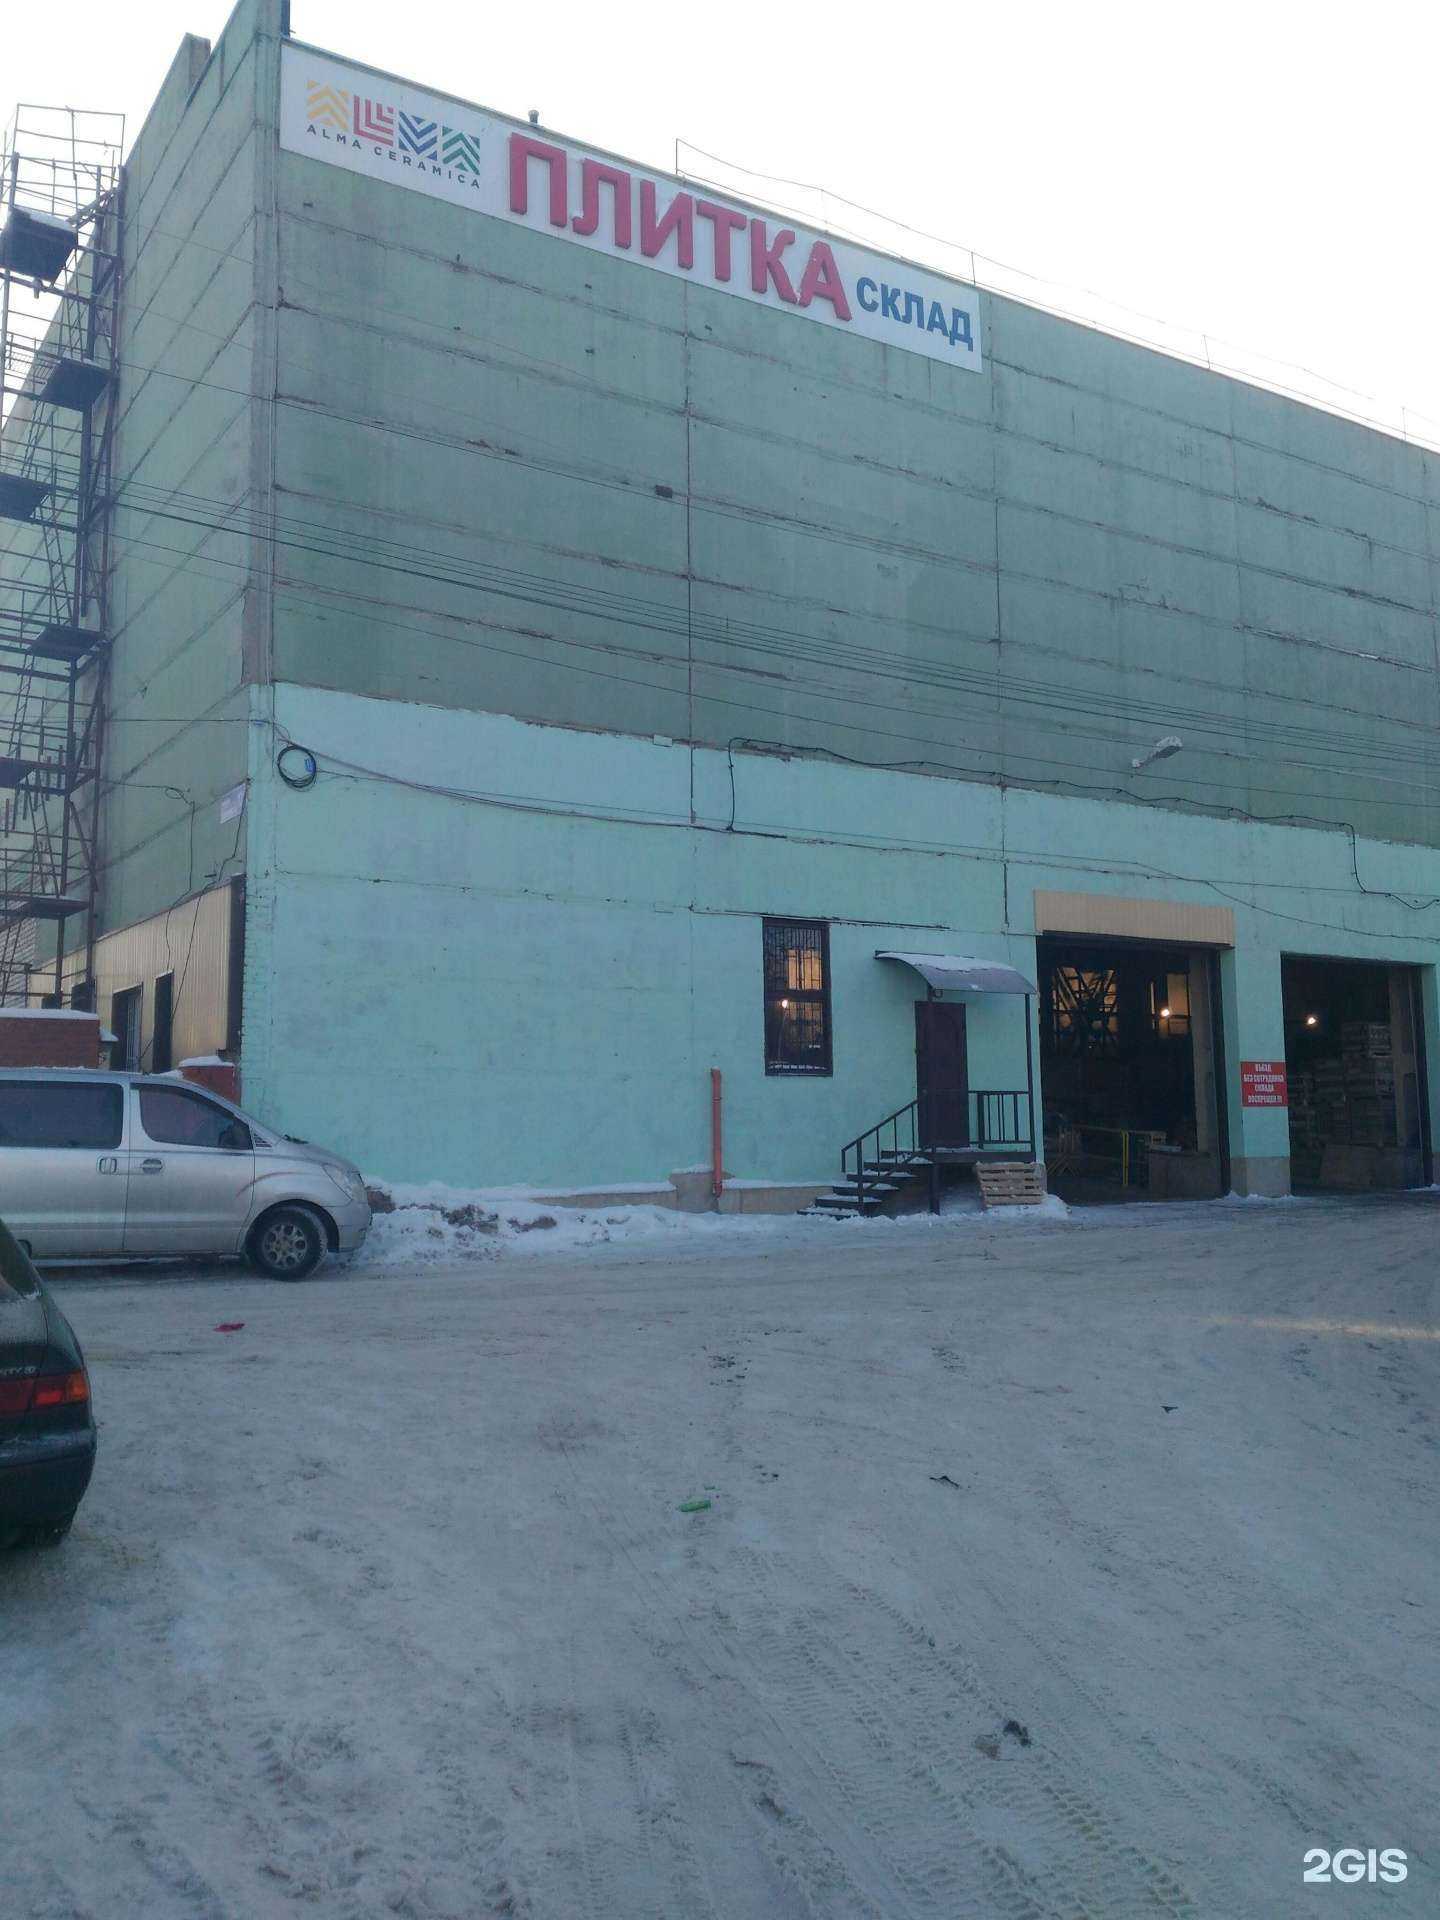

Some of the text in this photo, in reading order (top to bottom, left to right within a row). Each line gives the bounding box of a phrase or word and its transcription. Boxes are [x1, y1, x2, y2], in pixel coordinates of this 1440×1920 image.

[306, 124, 481, 189] ALMA CERAMICA
[507, 131, 974, 353] ПЛИТКА СКЛАД
